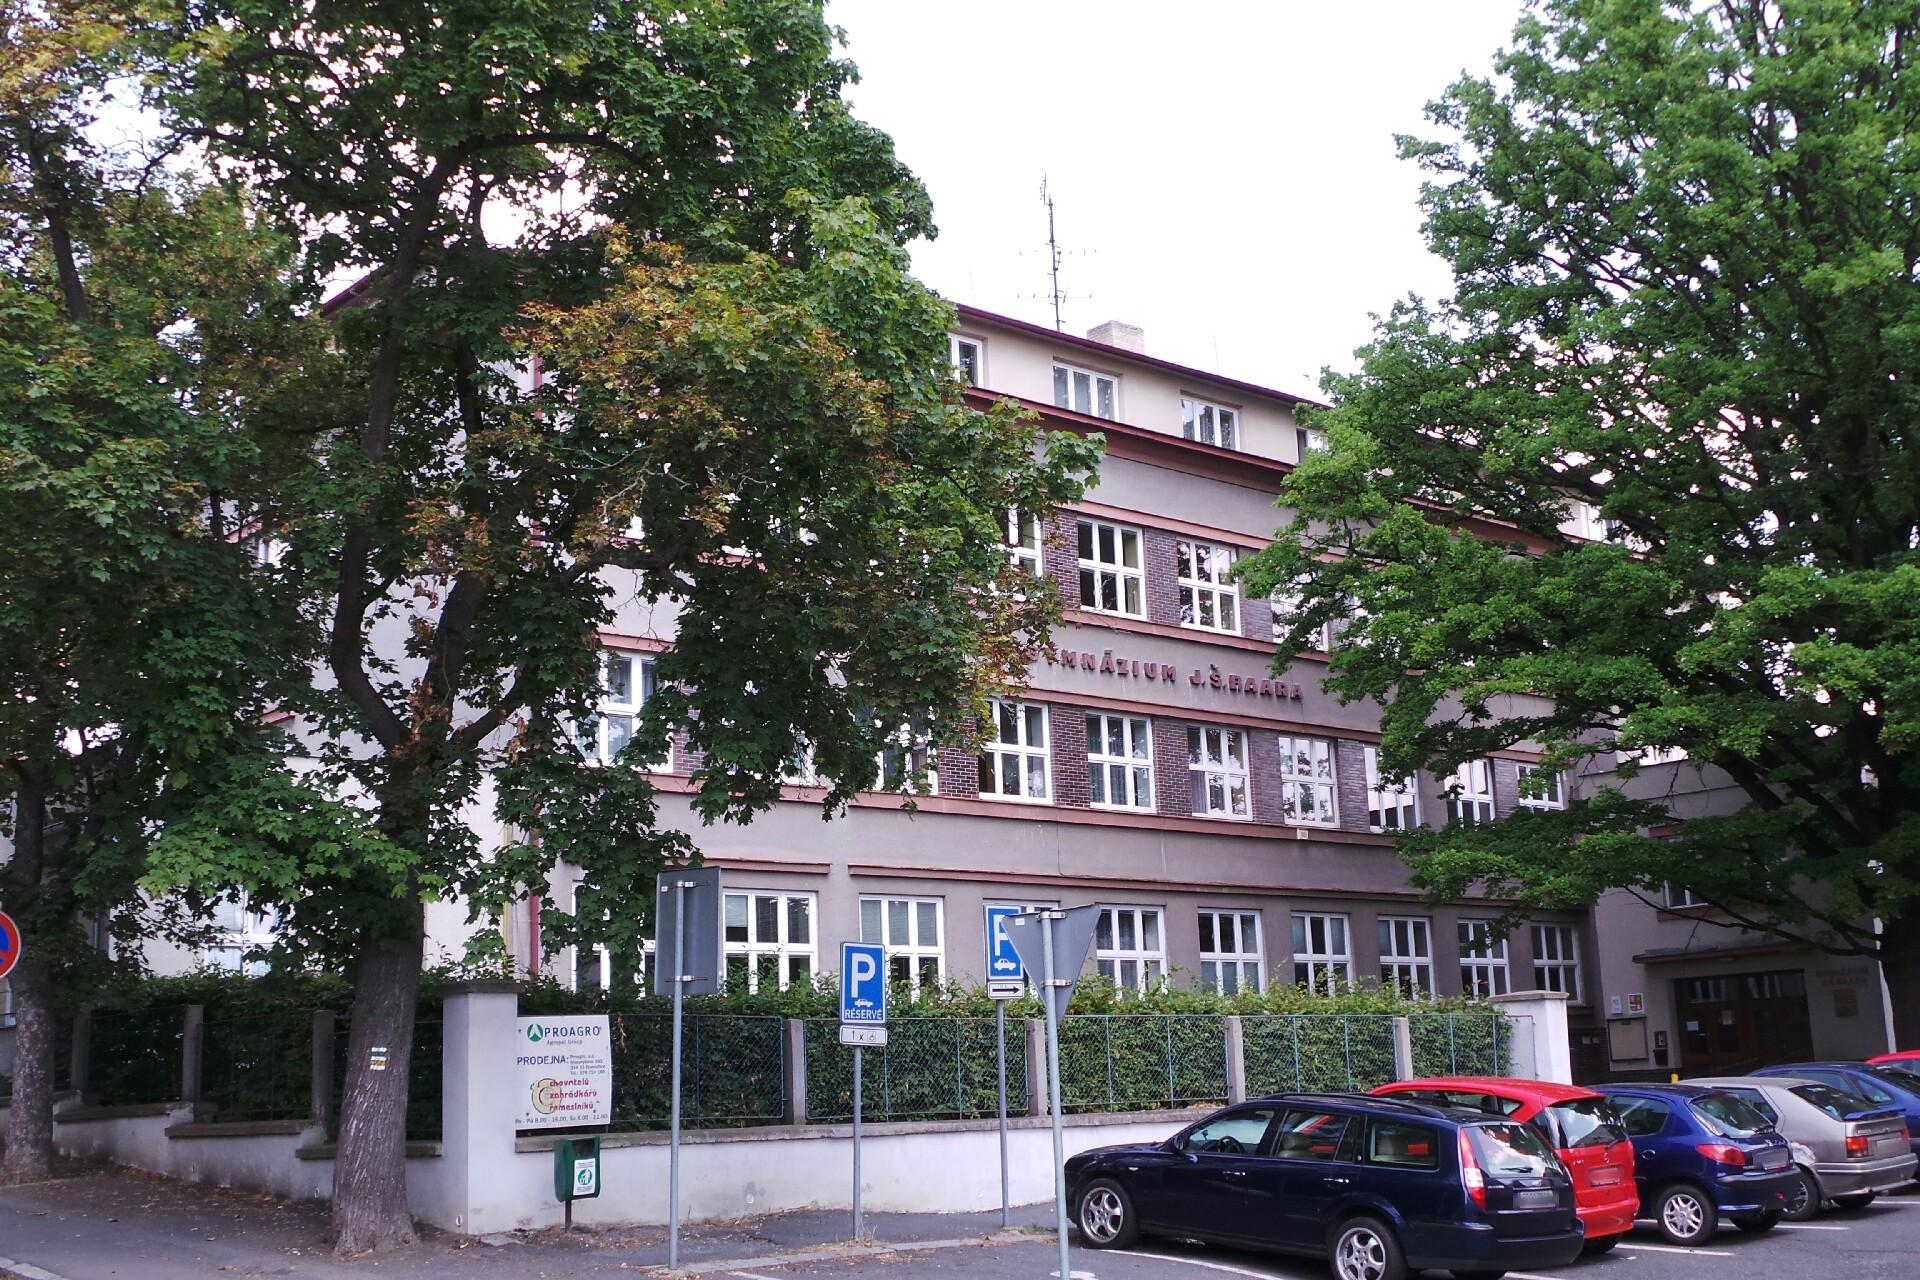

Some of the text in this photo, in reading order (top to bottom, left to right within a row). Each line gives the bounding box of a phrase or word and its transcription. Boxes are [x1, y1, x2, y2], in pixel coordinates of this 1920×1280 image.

[1026, 647, 1177, 683] GMNÁZIUM
[851, 953, 876, 998] P
[844, 1007, 882, 1020] RÉSERVÉ
[544, 1026, 600, 1038] PROAGRO
[517, 1055, 569, 1065] PRODEJNA:
